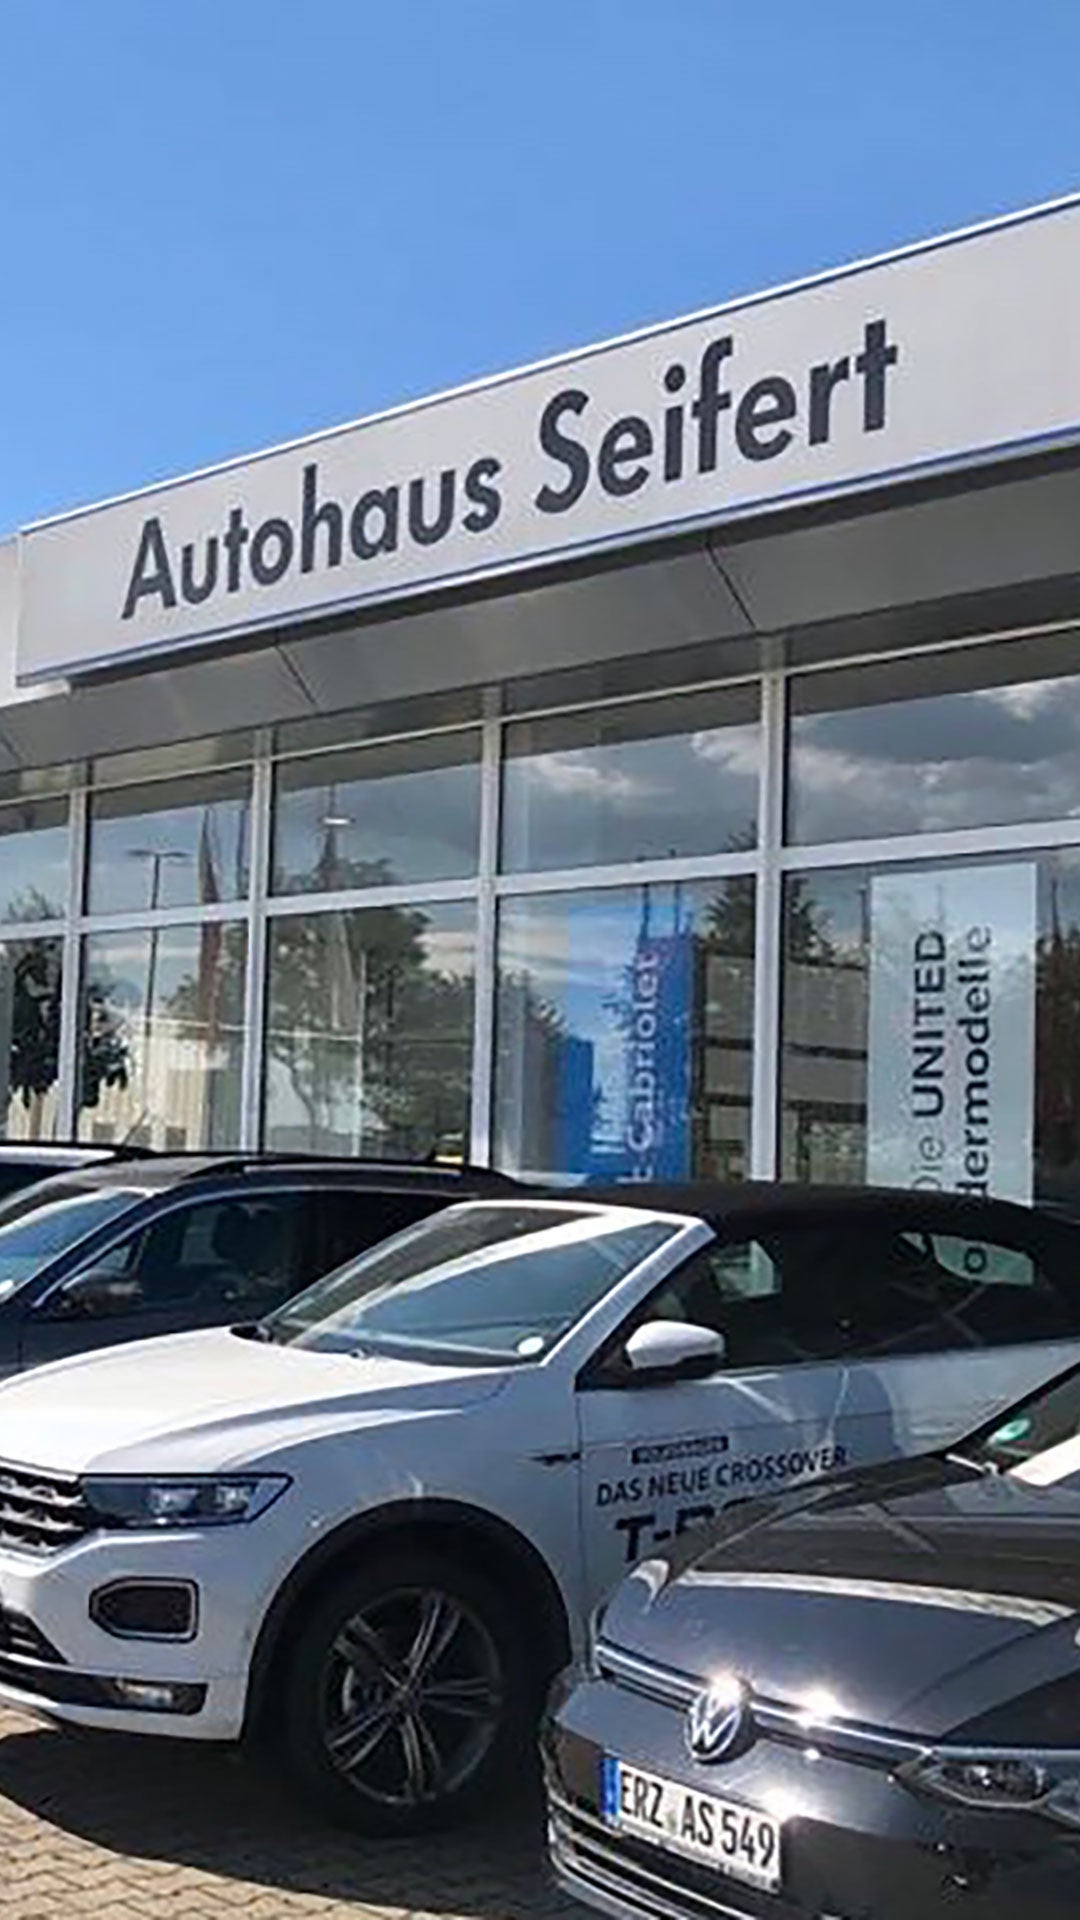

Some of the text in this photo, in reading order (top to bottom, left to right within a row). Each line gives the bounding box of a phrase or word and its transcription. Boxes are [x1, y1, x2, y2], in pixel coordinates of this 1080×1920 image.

[121, 319, 898, 620] Autohaus Seifert
[628, 950, 659, 1150] Cabriolet
[913, 931, 945, 1117] UNITED
[597, 1477, 642, 1506] DAS
[648, 1467, 709, 1497] NEUE
[716, 1445, 847, 1487] CROSSOVER
[620, 1771, 775, 1867] ERZ AS 549
